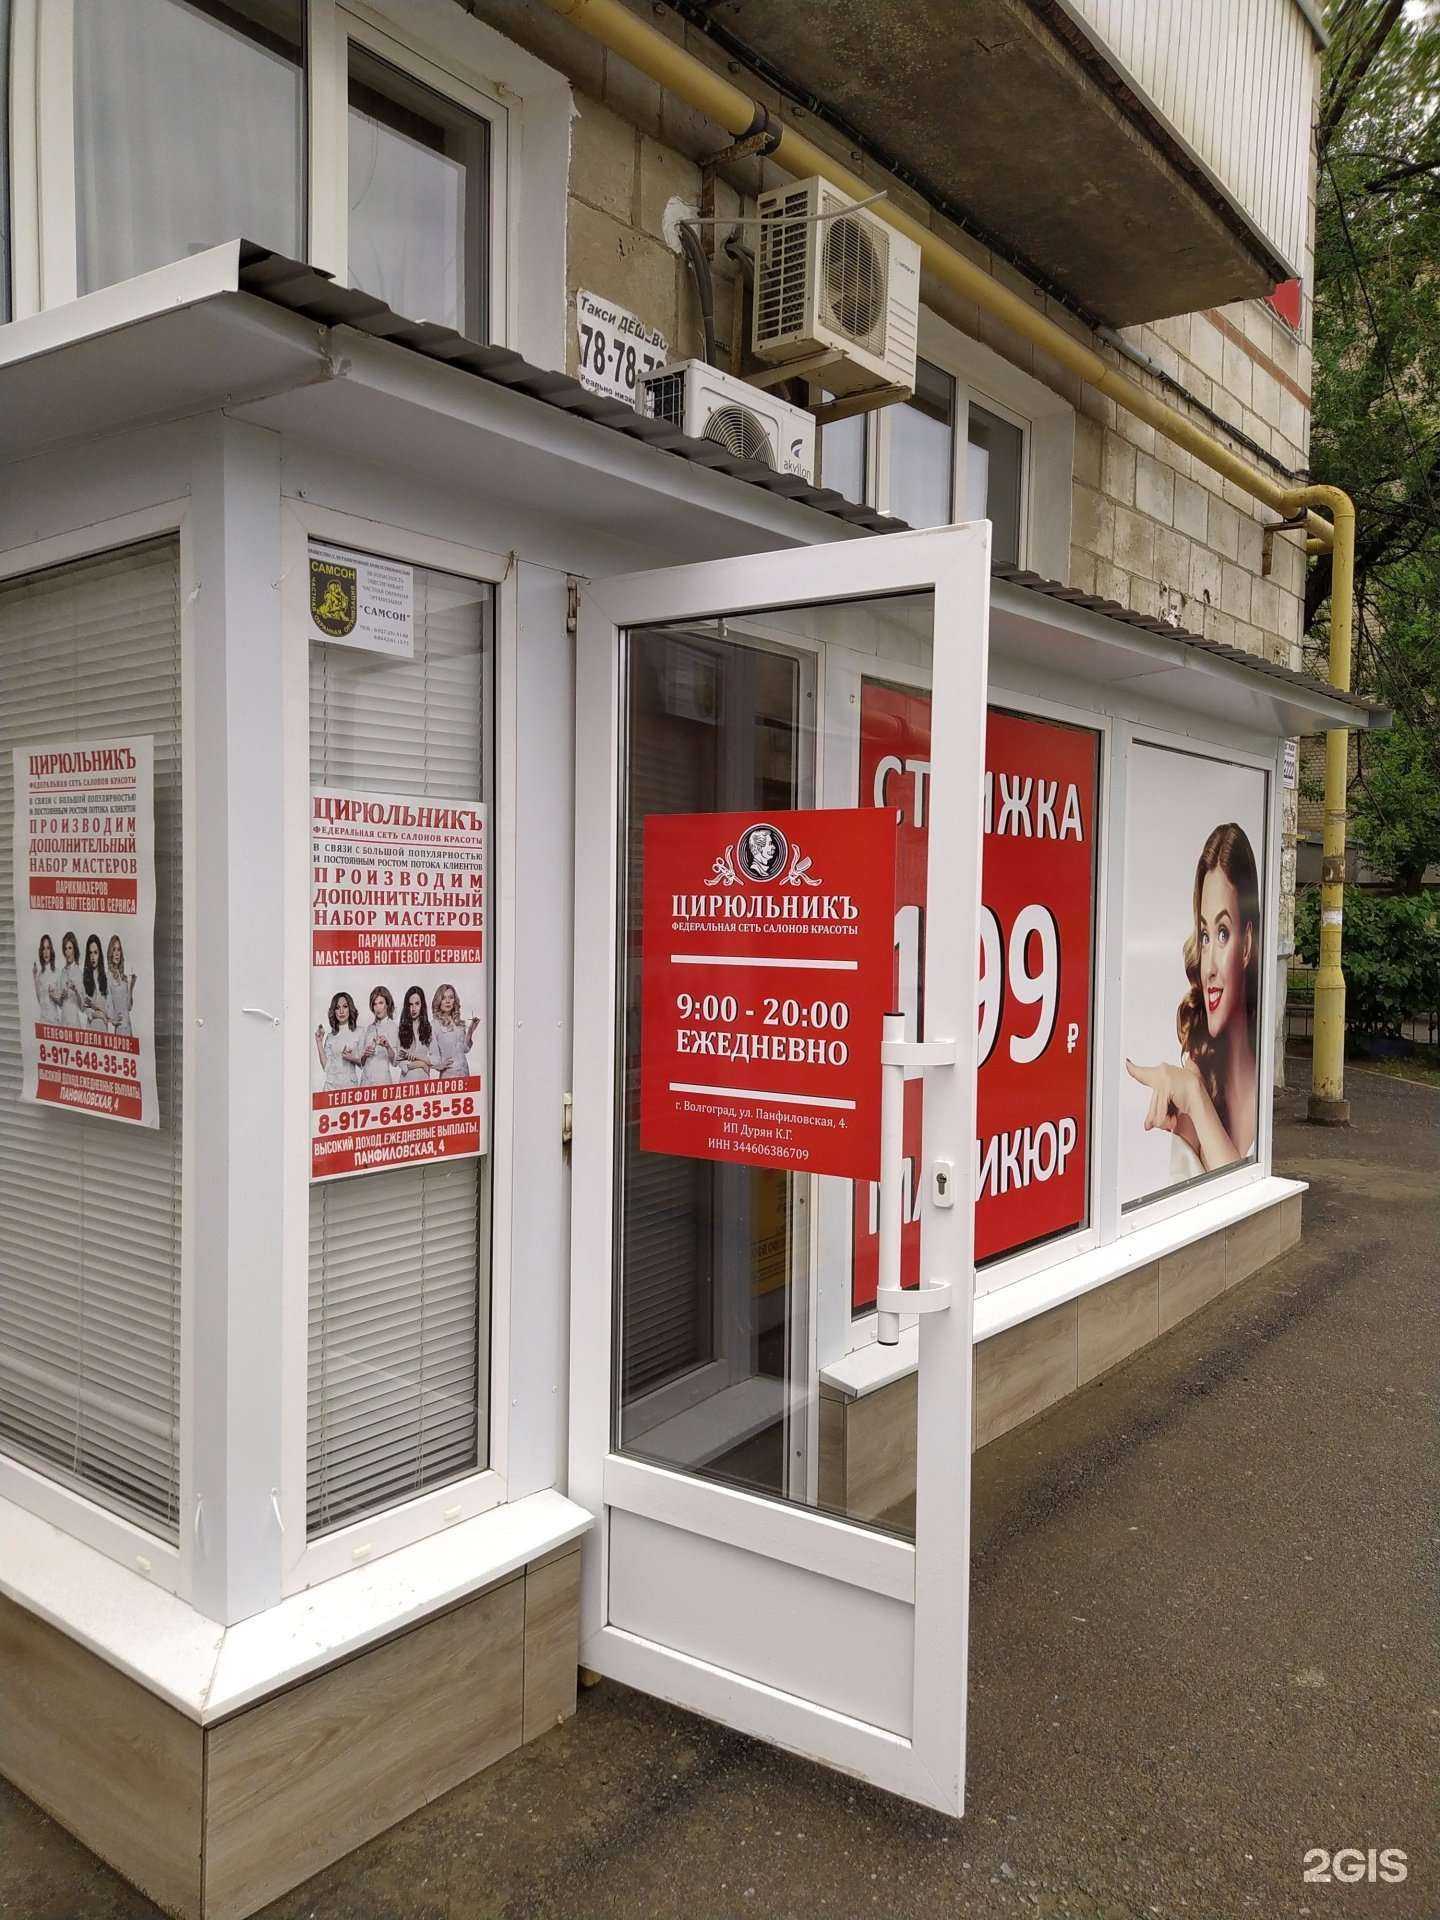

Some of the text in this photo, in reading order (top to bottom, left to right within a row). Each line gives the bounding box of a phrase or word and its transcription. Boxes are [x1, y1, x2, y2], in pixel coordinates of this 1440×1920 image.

[581, 296, 668, 350] Такси ДЁШВ
[581, 374, 636, 405] Реально низк
[311, 561, 356, 580] САМСОН
[29, 748, 136, 780] ЦИРЮЛЬНИКЪ
[874, 755, 1083, 841] СТЖКА
[29, 817, 136, 835] ПРОИЗВОДИМ
[313, 797, 483, 831] ЦИРЮЛЬНИКЪ
[29, 833, 136, 855] ДОПОЛНИТЕЛЬНЫЙ
[313, 826, 482, 845] ФЕДЕРАЛЬНАЯ СЕТЬ САЛОНОВ КРАСОТЫ
[313, 843, 320, 851] В
[324, 843, 355, 854] СВЯЗИ
[363, 845, 404, 857] БОЛЬШОЙ
[408, 850, 482, 860] ПОПУЛЯРНОСТЬЮ
[324, 855, 375, 866] ПОСТОЯННЫМ
[377, 858, 408, 868] РОСТОМ
[411, 860, 440, 870] ПОТОКА
[443, 862, 482, 871] КЛИЕНТОВ
[29, 858, 137, 873] НАБОР МАСТЕРОВ
[55, 880, 108, 896] ПАРИКМАХЕРОВ
[314, 867, 482, 890] ПРОИЗВОДИМ
[31, 896, 136, 914] МАСТЕРОВ НОГТЕВОГО СЕРВИСА
[313, 888, 482, 907] ДОПОЛНИТЕЛЬНЫЙ
[671, 894, 859, 920] ЦИРЮЛЬНИКЪ
[314, 909, 483, 926] НАБОР МАСТЕРОВ
[671, 921, 858, 935] ФЕДЕРАЛЬНАЯ СЕТЬ САЛОНОВ КРАСОТЫ
[358, 933, 436, 948] ПАРИКМАХЕРОВ
[315, 949, 481, 965] МАСТЕРОВ НОГТЕВОГО СЕРВИСА
[676, 993, 738, 1022] 9:00
[763, 998, 849, 1030] 20:00
[43, 1026, 133, 1052] ТЕЛЕФОН ОТДЕЛА КАДРОВ:
[676, 1029, 849, 1066] ЕЖЕДНЕВНО
[39, 1043, 137, 1078] 8-917-648-35-58
[60, 1086, 119, 1112] ПАНФИЛОВСКАЯ, 4
[328, 1079, 469, 1106] ТЕЛЕФОН ОТДЕЛА КАДРОВ:
[318, 1097, 475, 1134] 8-917-648-35-58
[675, 1101, 848, 1129] г. Волгоград, ул. Панфиловская, 4.
[314, 1137, 354, 1156] ВЫСОКИЙ
[437, 1122, 479, 1137] ВЫПЛАТЫ.
[723, 1122, 793, 1141] ИП Дурян К.Г.
[354, 1140, 445, 1167] ПАНФИЛОВСКАЯ, 4
[708, 1138, 809, 1161] ИНН 344606386709
[869, 1117, 1077, 1235] МИКЮР
